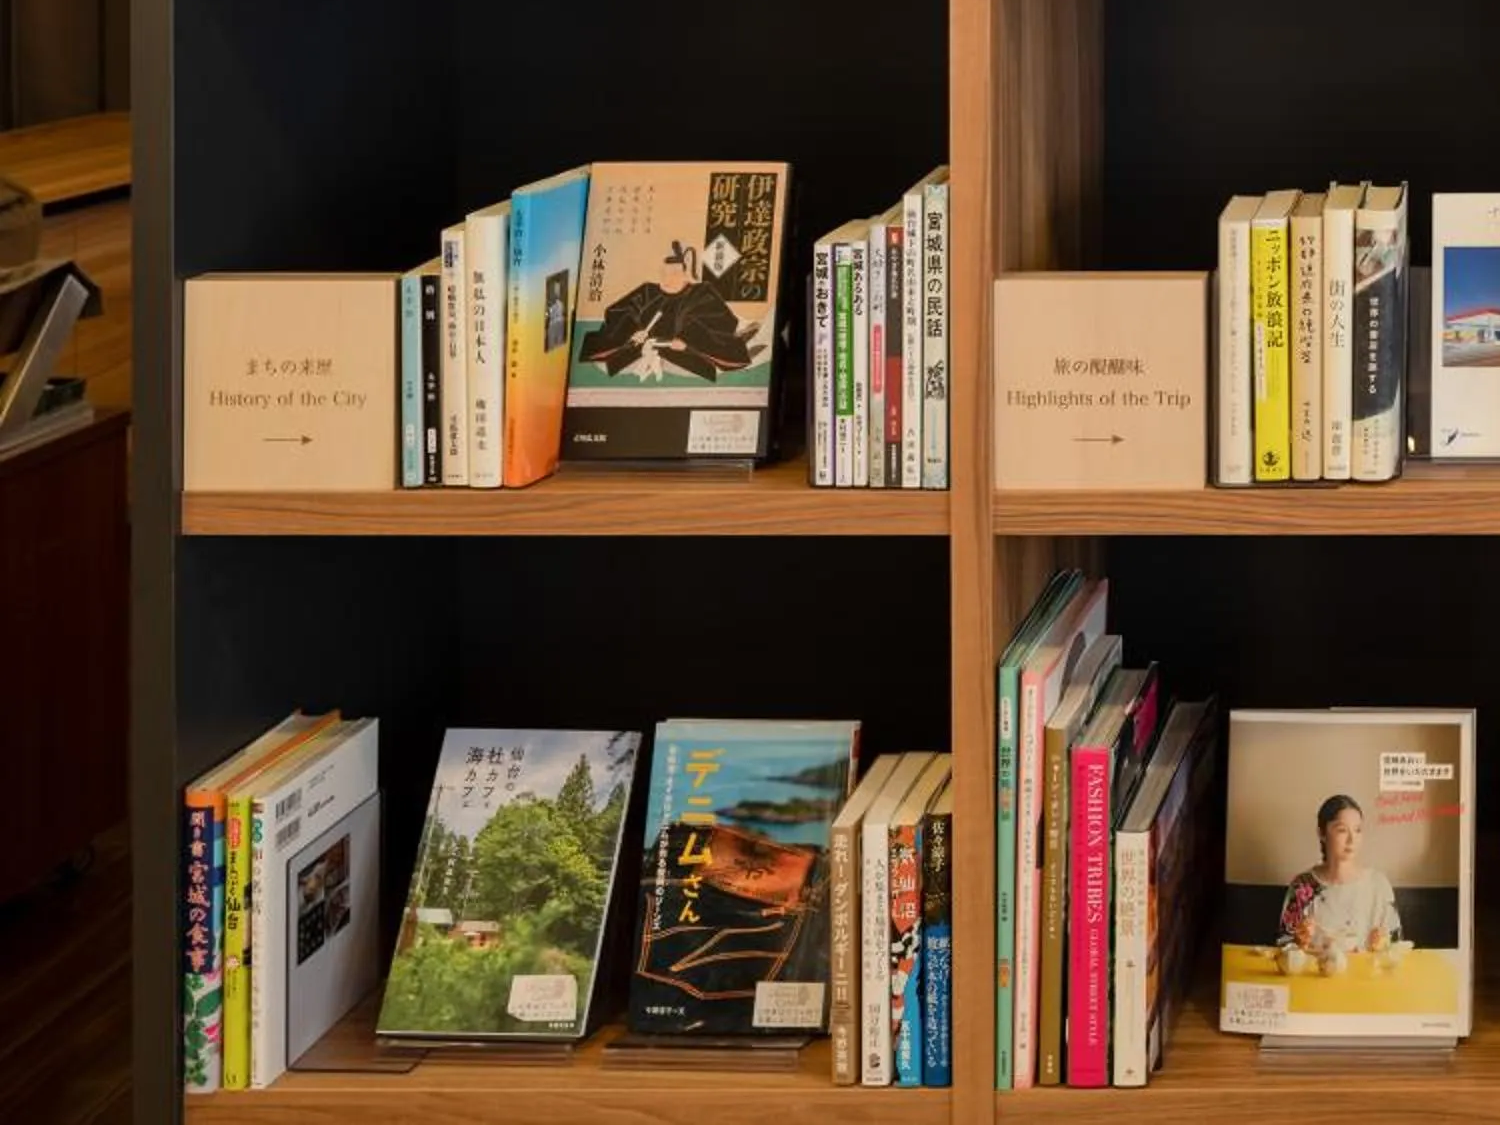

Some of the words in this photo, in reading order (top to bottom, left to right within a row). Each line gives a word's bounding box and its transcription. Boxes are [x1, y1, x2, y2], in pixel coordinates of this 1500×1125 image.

[711, 173, 740, 229] 研究
[740, 174, 774, 299] 伊達政宗の
[926, 212, 944, 338] 宮城県の民話
[1265, 230, 1284, 349] ニッポン放浪記
[1329, 279, 1346, 348] 街の人生
[209, 390, 271, 410] History
[277, 390, 295, 407] of
[301, 390, 327, 407] the
[333, 390, 367, 409] City
[246, 359, 333, 375] まちの来歴
[1007, 389, 1093, 410] Highlights
[1099, 389, 1116, 407] of
[1122, 389, 1149, 407] the
[1153, 389, 1191, 410] Trip
[1053, 357, 1146, 376] 旅の醍醐味
[677, 747, 727, 925] デニムさん
[1087, 764, 1104, 847] FASHION
[1087, 852, 1103, 923] TRIBES
